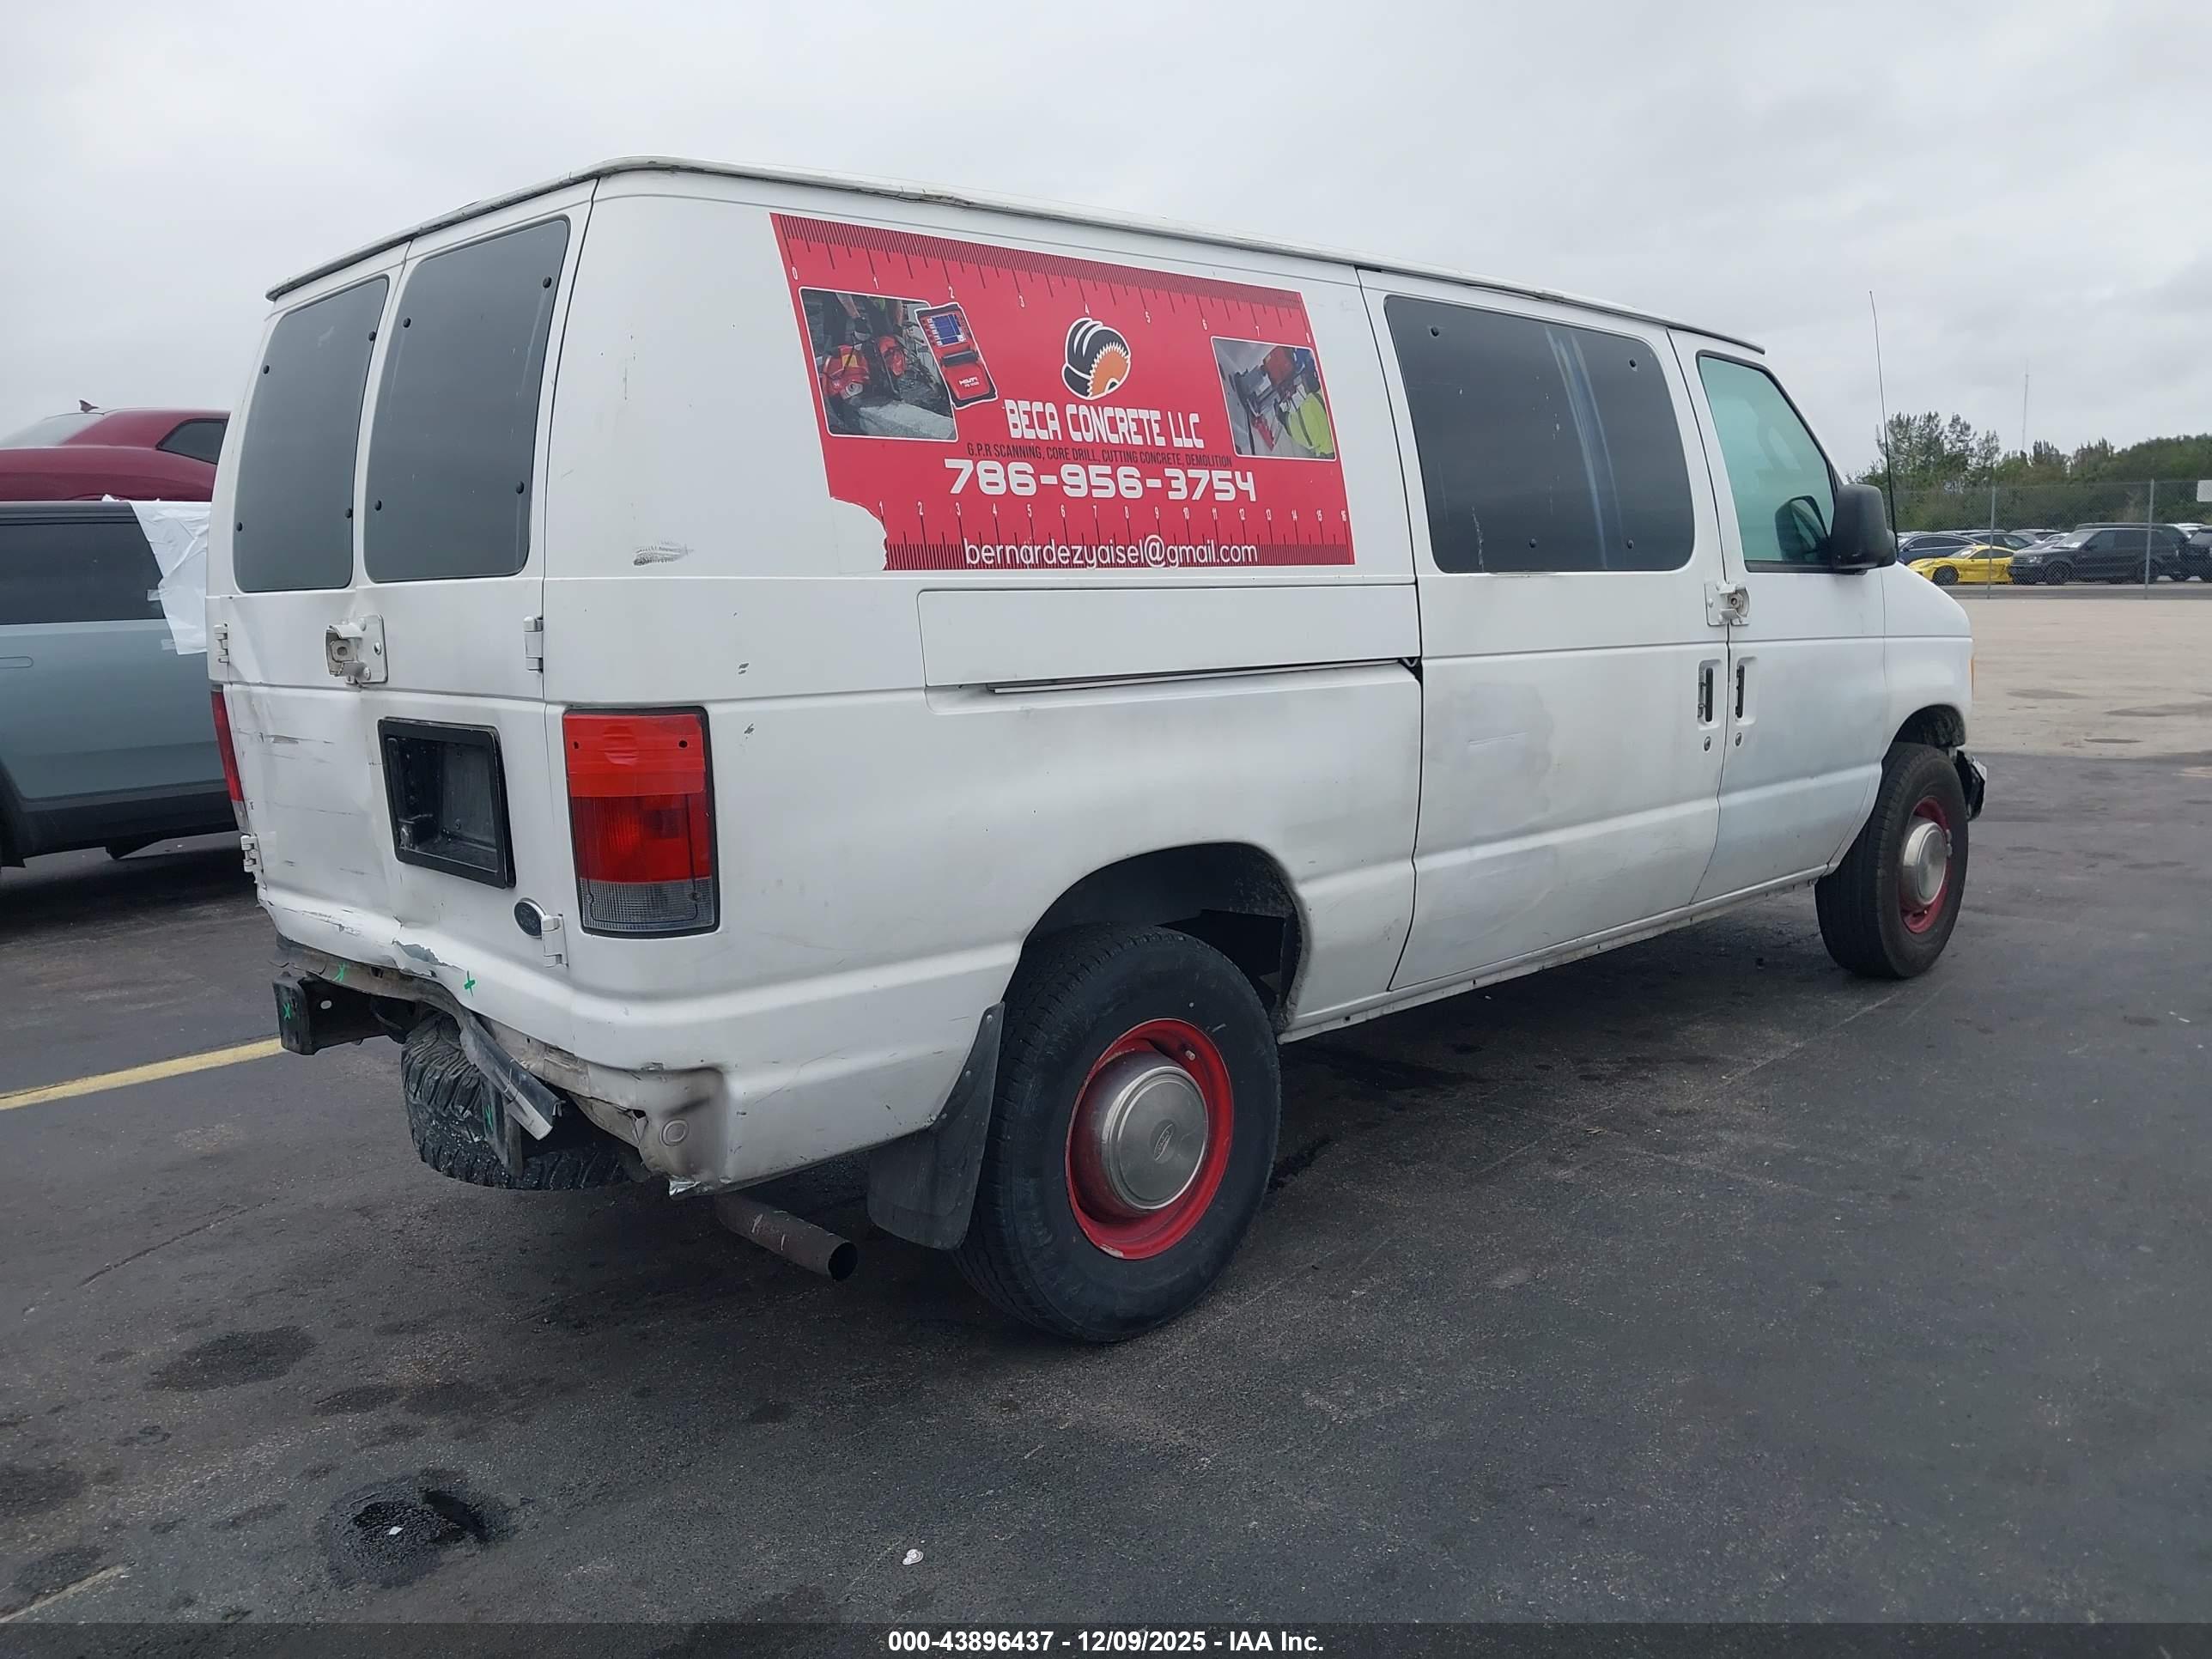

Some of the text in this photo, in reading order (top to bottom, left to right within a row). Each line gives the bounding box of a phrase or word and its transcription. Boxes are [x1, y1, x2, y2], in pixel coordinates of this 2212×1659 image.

[791, 266, 799, 280] 0
[873, 276, 879, 289] 1
[948, 286, 955, 299] 2
[1018, 295, 1024, 307] 3
[1085, 303, 1090, 315] 4
[1145, 311, 1151, 323] 5
[1004, 399, 1205, 448] BECA CONCRETE LLC
[967, 442, 1232, 468] G.P.R SCANNING, CORE DRILL, CUTTING CONCRETE, DEMOLITION
[945, 459, 1256, 502] 786-956-3754
[879, 501, 884, 515] 1
[918, 501, 923, 516] 2
[956, 502, 961, 516] 3
[993, 503, 998, 516] 4
[1027, 503, 1032, 517] 5
[1060, 504, 1066, 518] 6
[1092, 505, 1097, 519] 7
[1124, 506, 1129, 520] 8
[1155, 507, 1160, 520] 9
[1183, 507, 1190, 520] 10
[1212, 507, 1218, 520] 11
[1239, 507, 1245, 520] 12
[1266, 507, 1272, 521] 13
[963, 535, 1258, 568] bernardezyaisel@gmail.com
